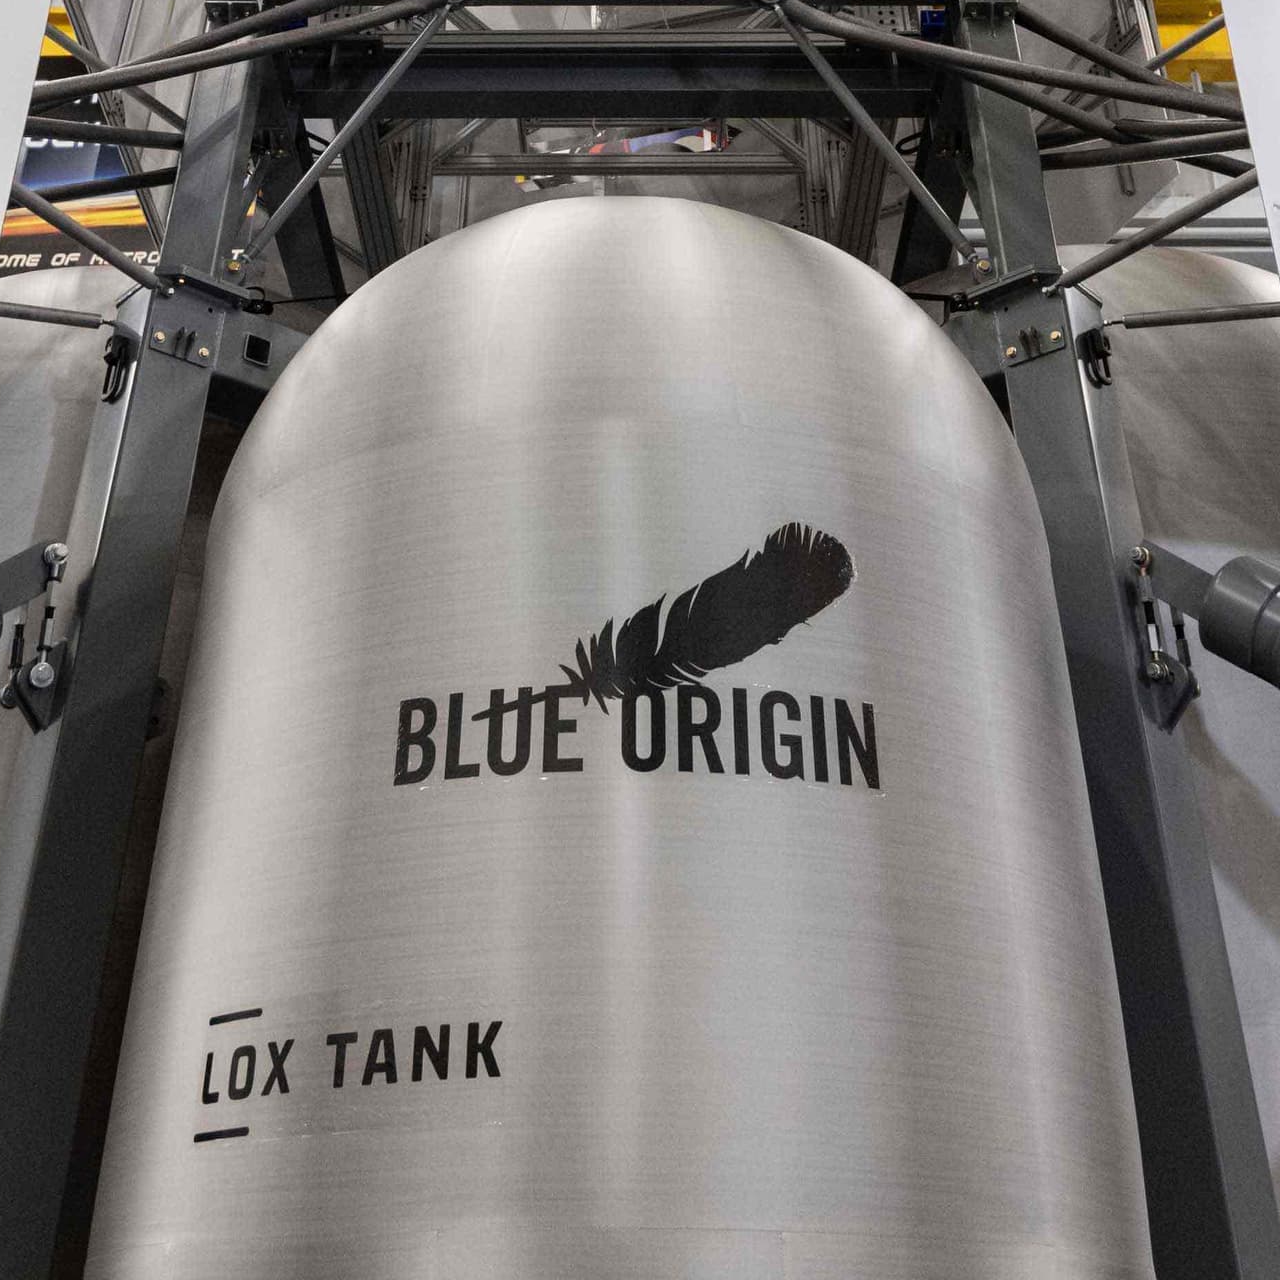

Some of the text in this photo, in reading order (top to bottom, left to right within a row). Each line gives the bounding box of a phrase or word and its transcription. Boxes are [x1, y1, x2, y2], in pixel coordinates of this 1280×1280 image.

[51, 252, 81, 267] OF
[393, 684, 881, 790] BLUE ORIGIN
[201, 1020, 504, 1105] LOX TANK
